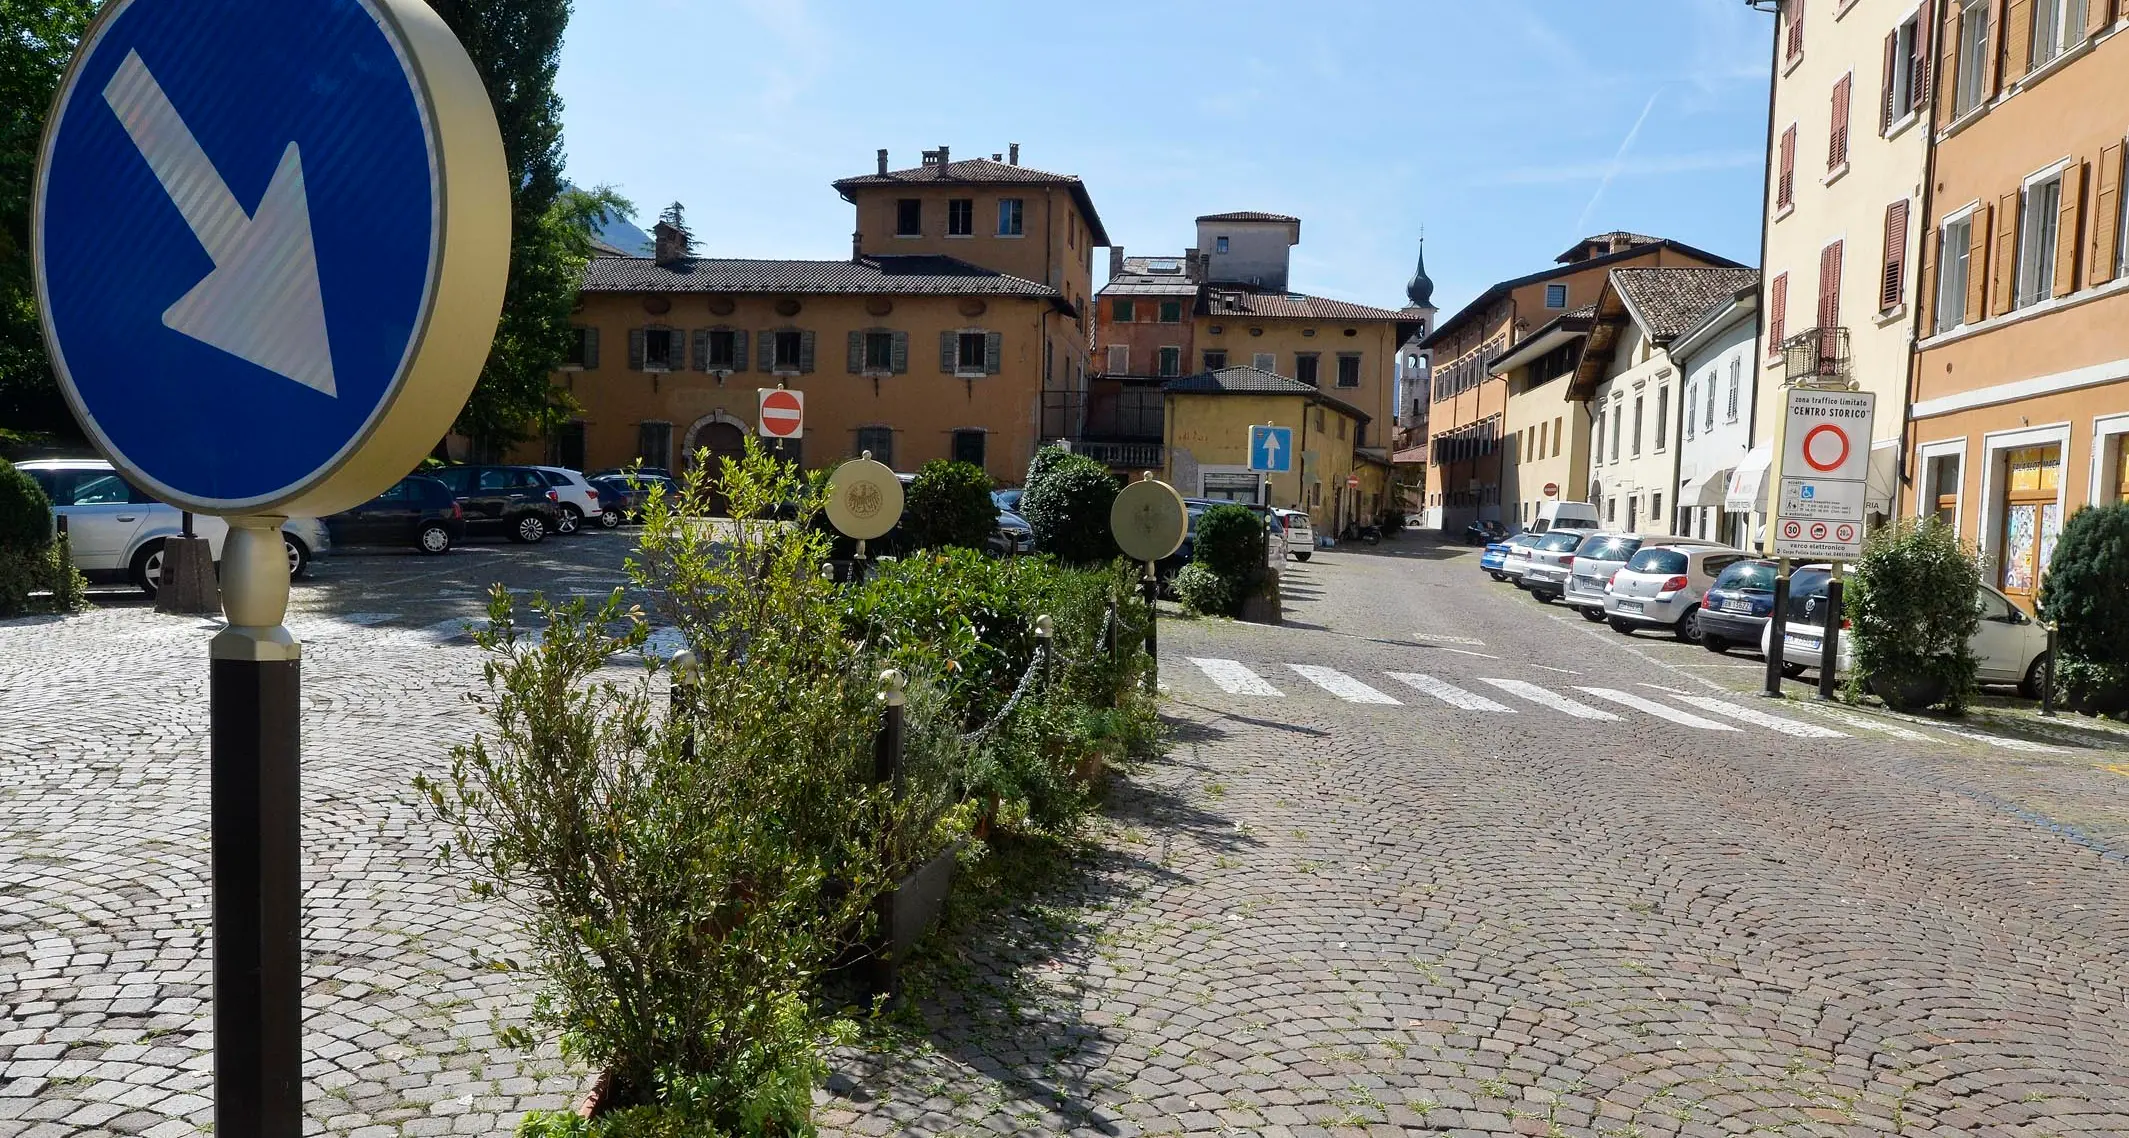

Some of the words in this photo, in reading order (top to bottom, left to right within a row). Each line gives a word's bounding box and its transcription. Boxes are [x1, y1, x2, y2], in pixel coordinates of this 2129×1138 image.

[1812, 396, 1838, 405] traffico
[1839, 398, 1867, 407] limitato
[1788, 526, 1798, 534] 30
